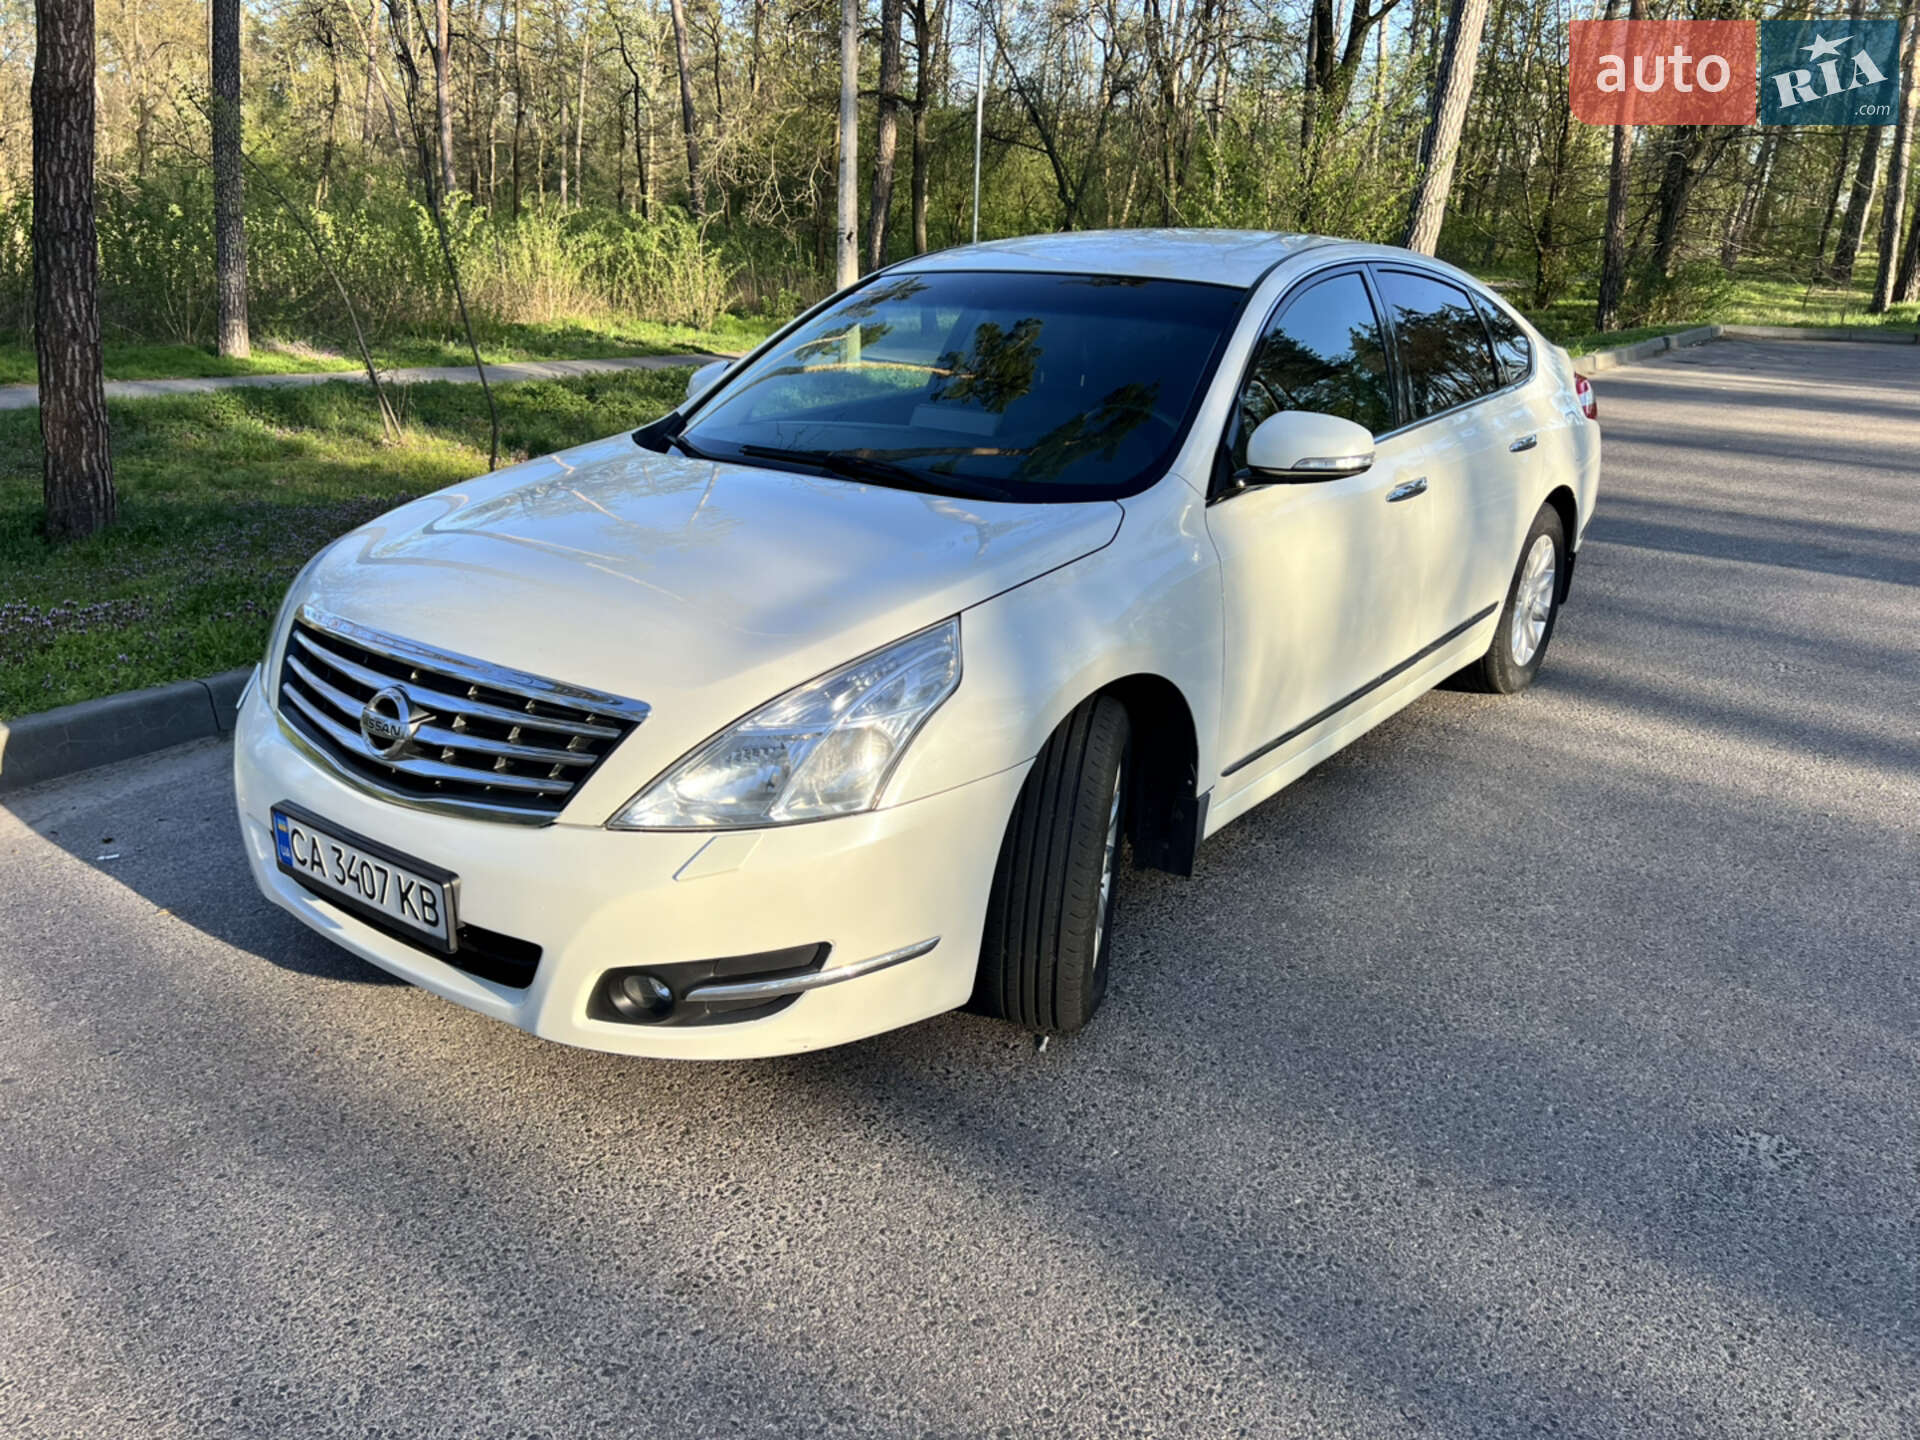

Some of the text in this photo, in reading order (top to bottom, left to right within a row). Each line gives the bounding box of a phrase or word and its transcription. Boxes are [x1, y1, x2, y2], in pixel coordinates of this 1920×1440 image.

[291, 827, 440, 928] CA 3407 KB
